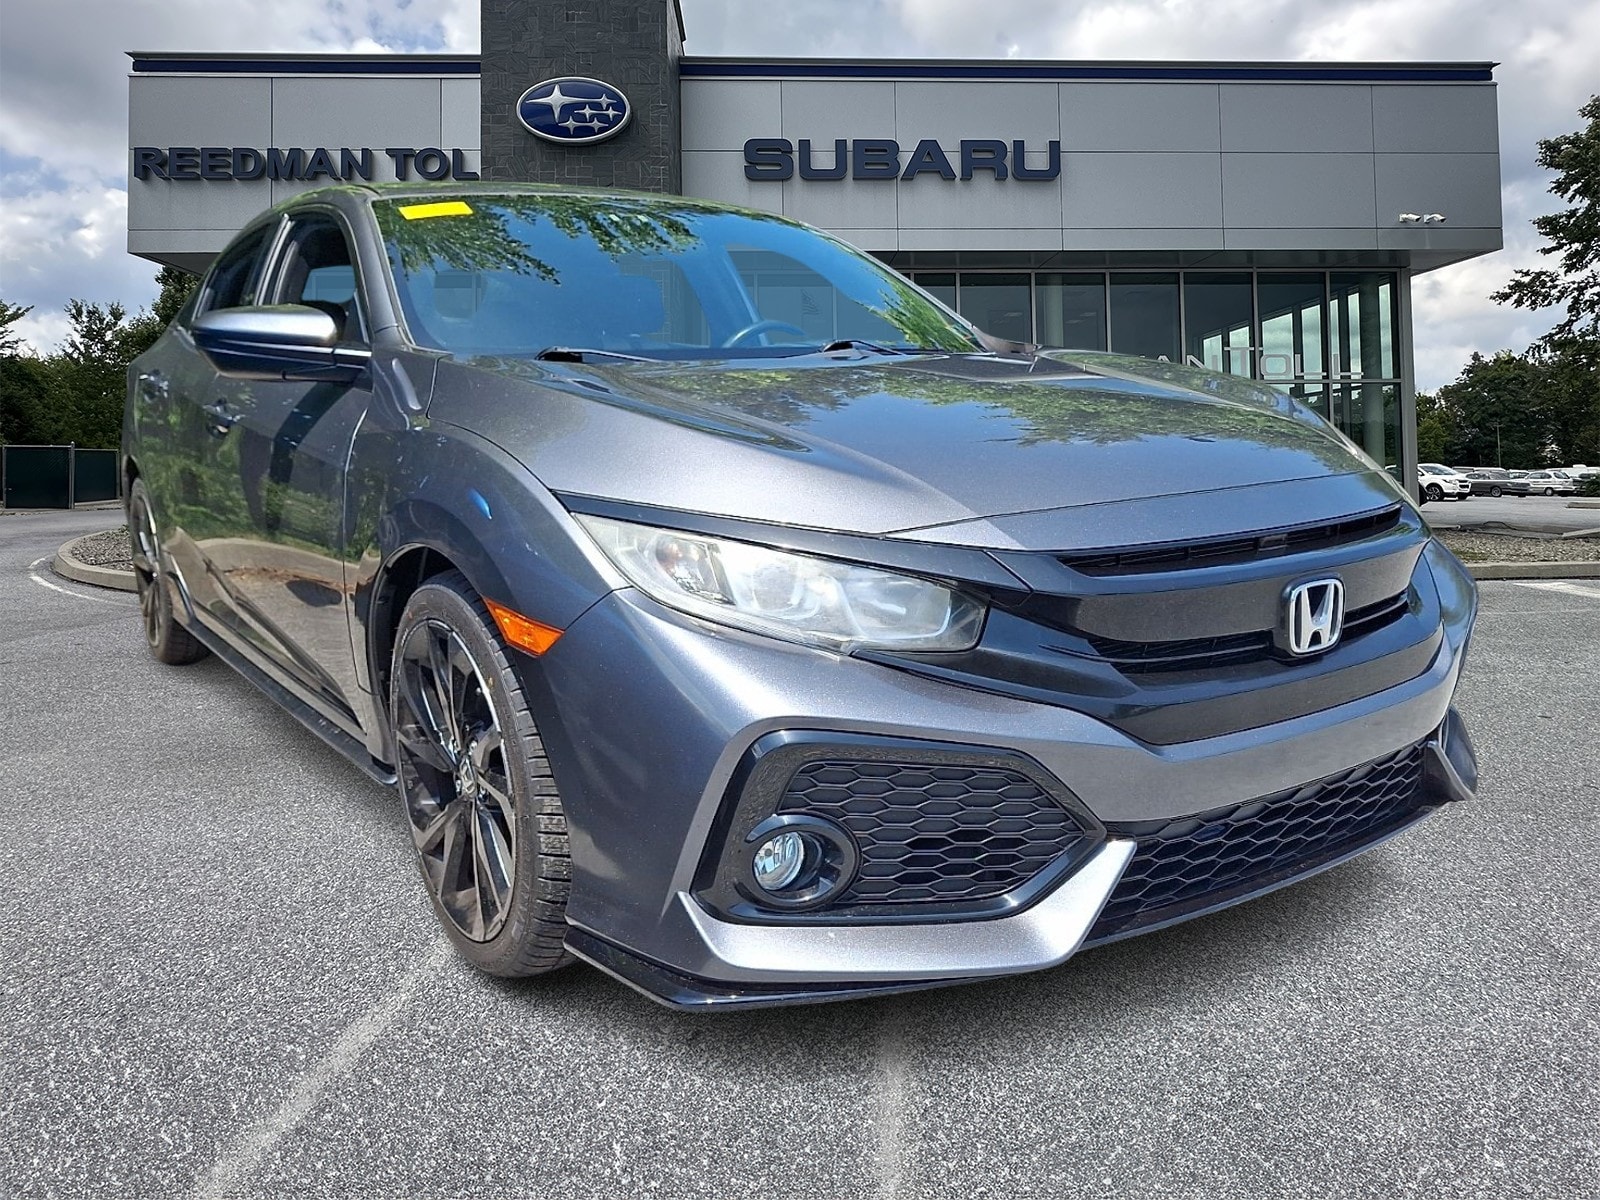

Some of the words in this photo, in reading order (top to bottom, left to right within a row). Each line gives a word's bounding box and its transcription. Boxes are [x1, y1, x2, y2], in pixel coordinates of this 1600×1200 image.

[134, 147, 376, 181] REEDMAN
[387, 147, 480, 181] TOL
[744, 138, 1061, 181] SUBARU
